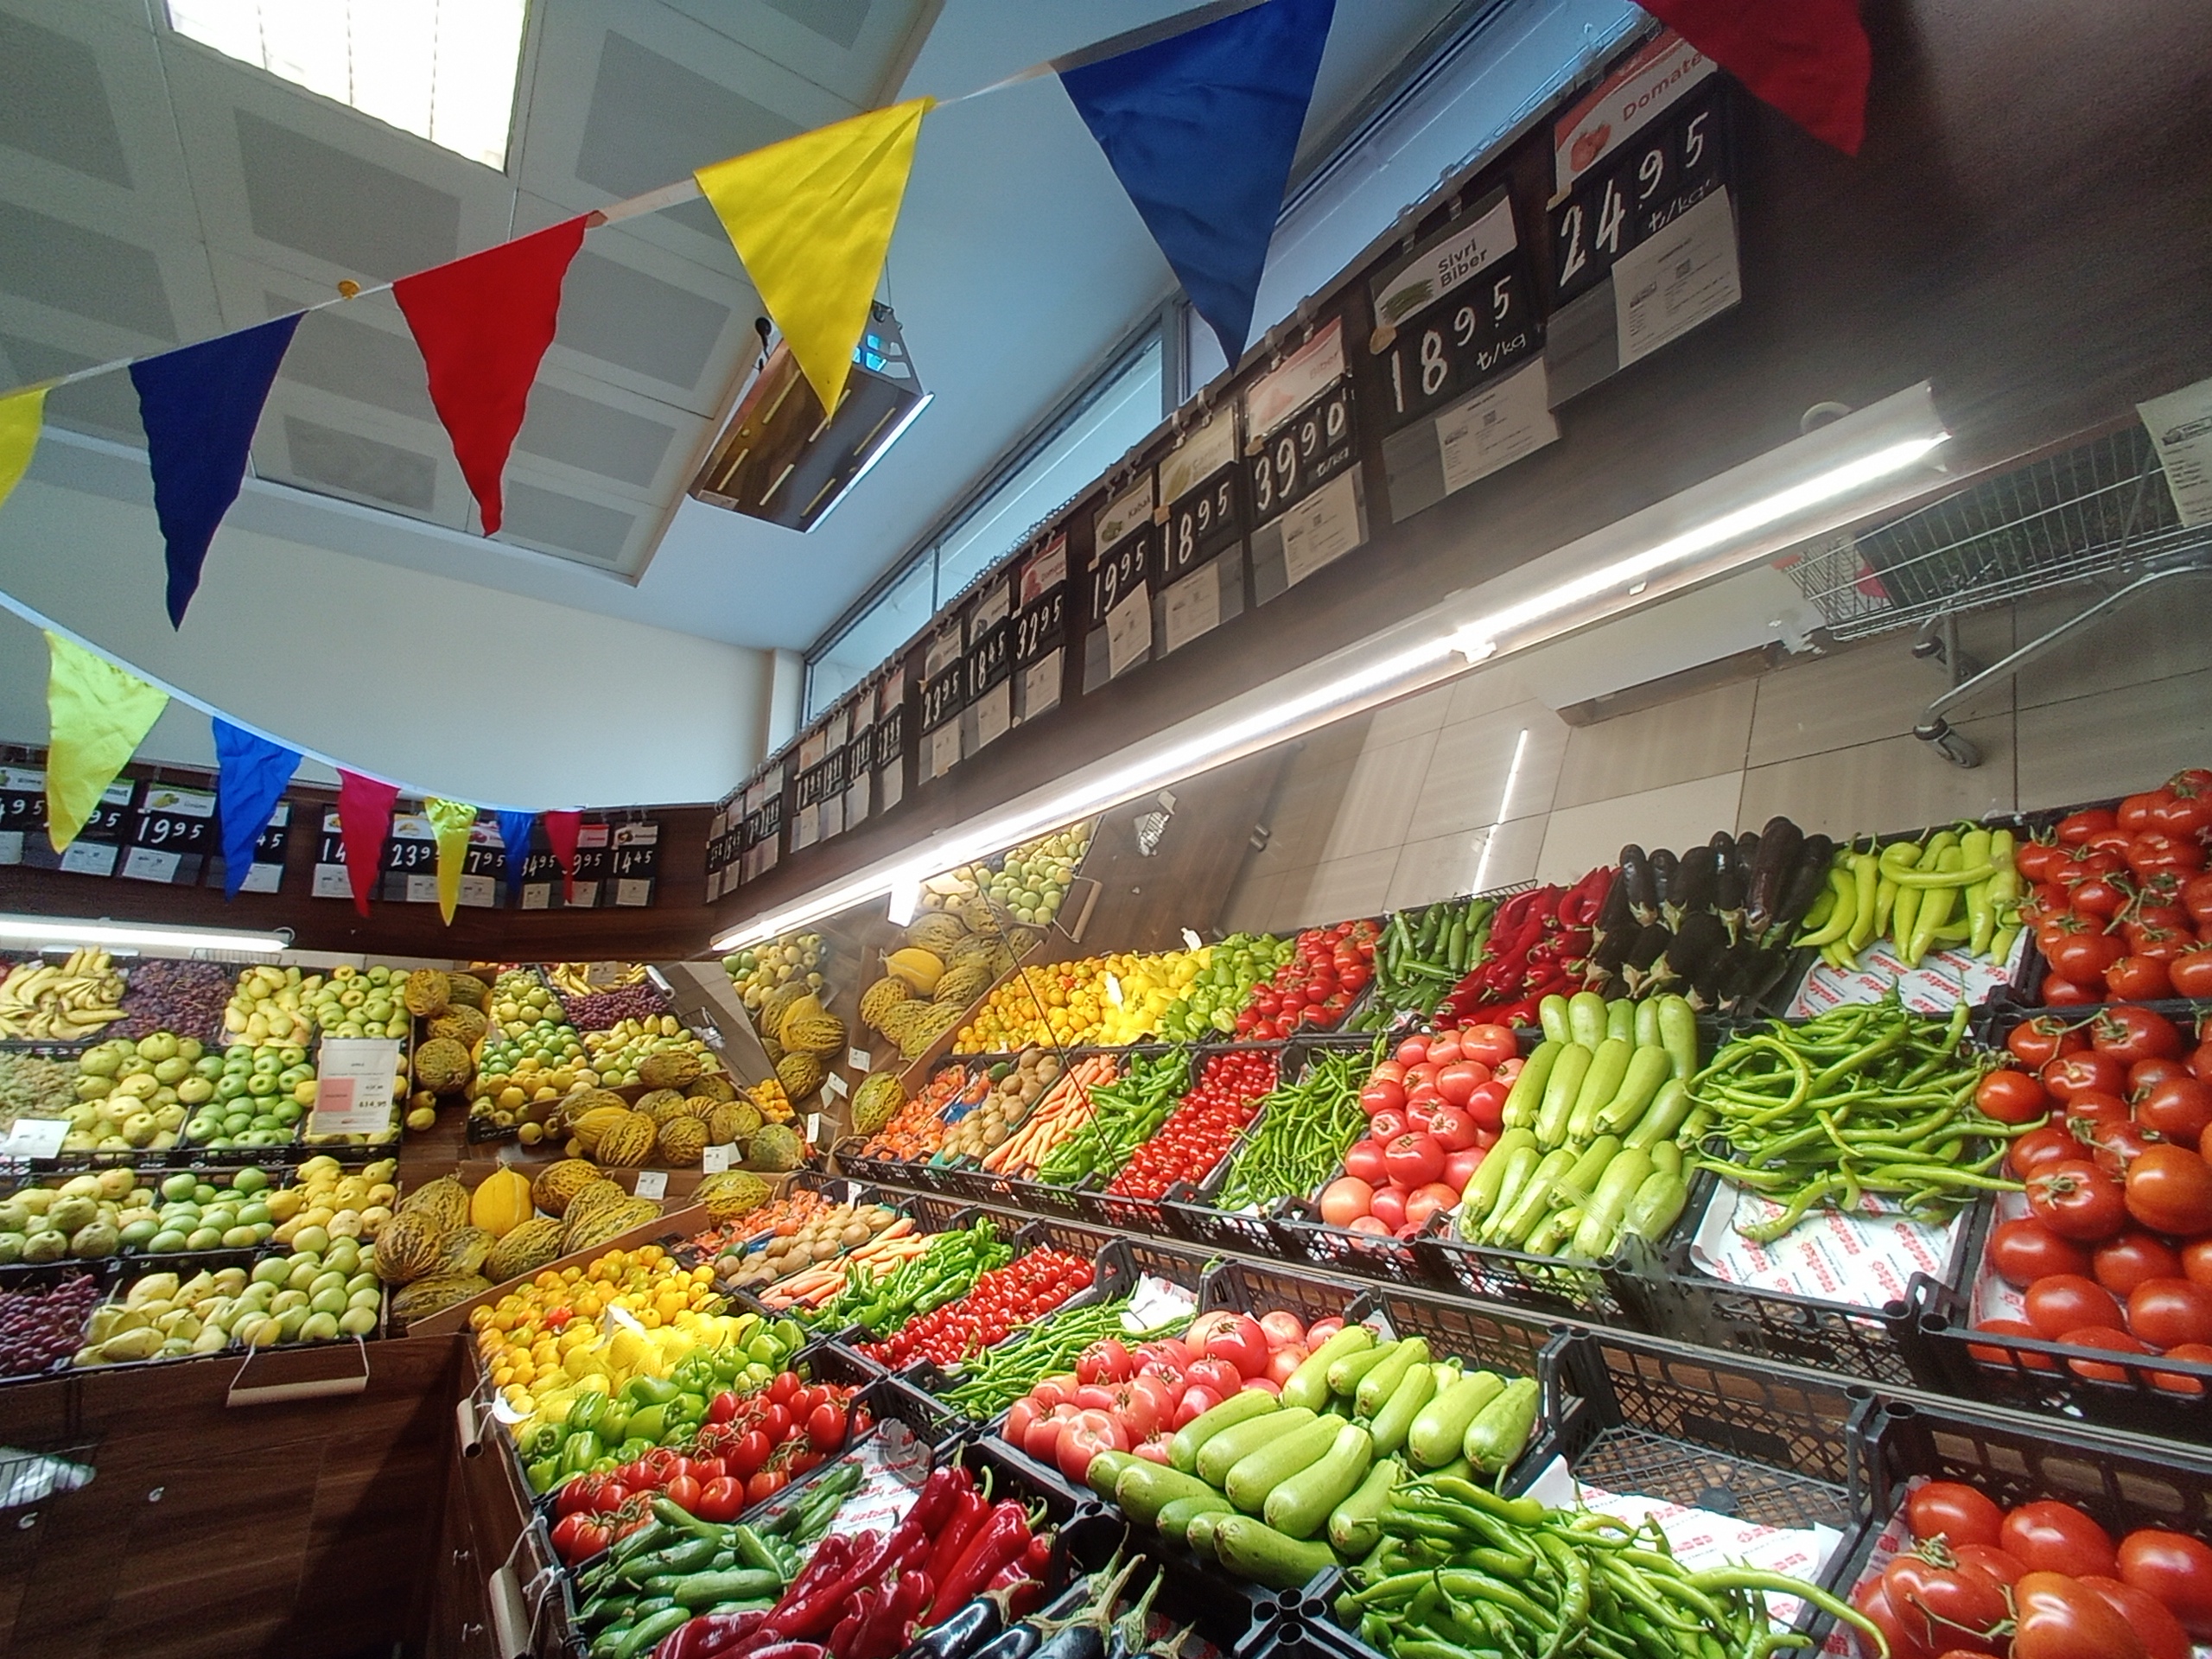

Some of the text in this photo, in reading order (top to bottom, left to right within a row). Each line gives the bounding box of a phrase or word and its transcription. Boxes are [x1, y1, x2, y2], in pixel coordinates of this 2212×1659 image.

[1622, 53, 1703, 122] Domate
[1437, 239, 1478, 273] Sivri
[1440, 249, 1488, 287] Biber
